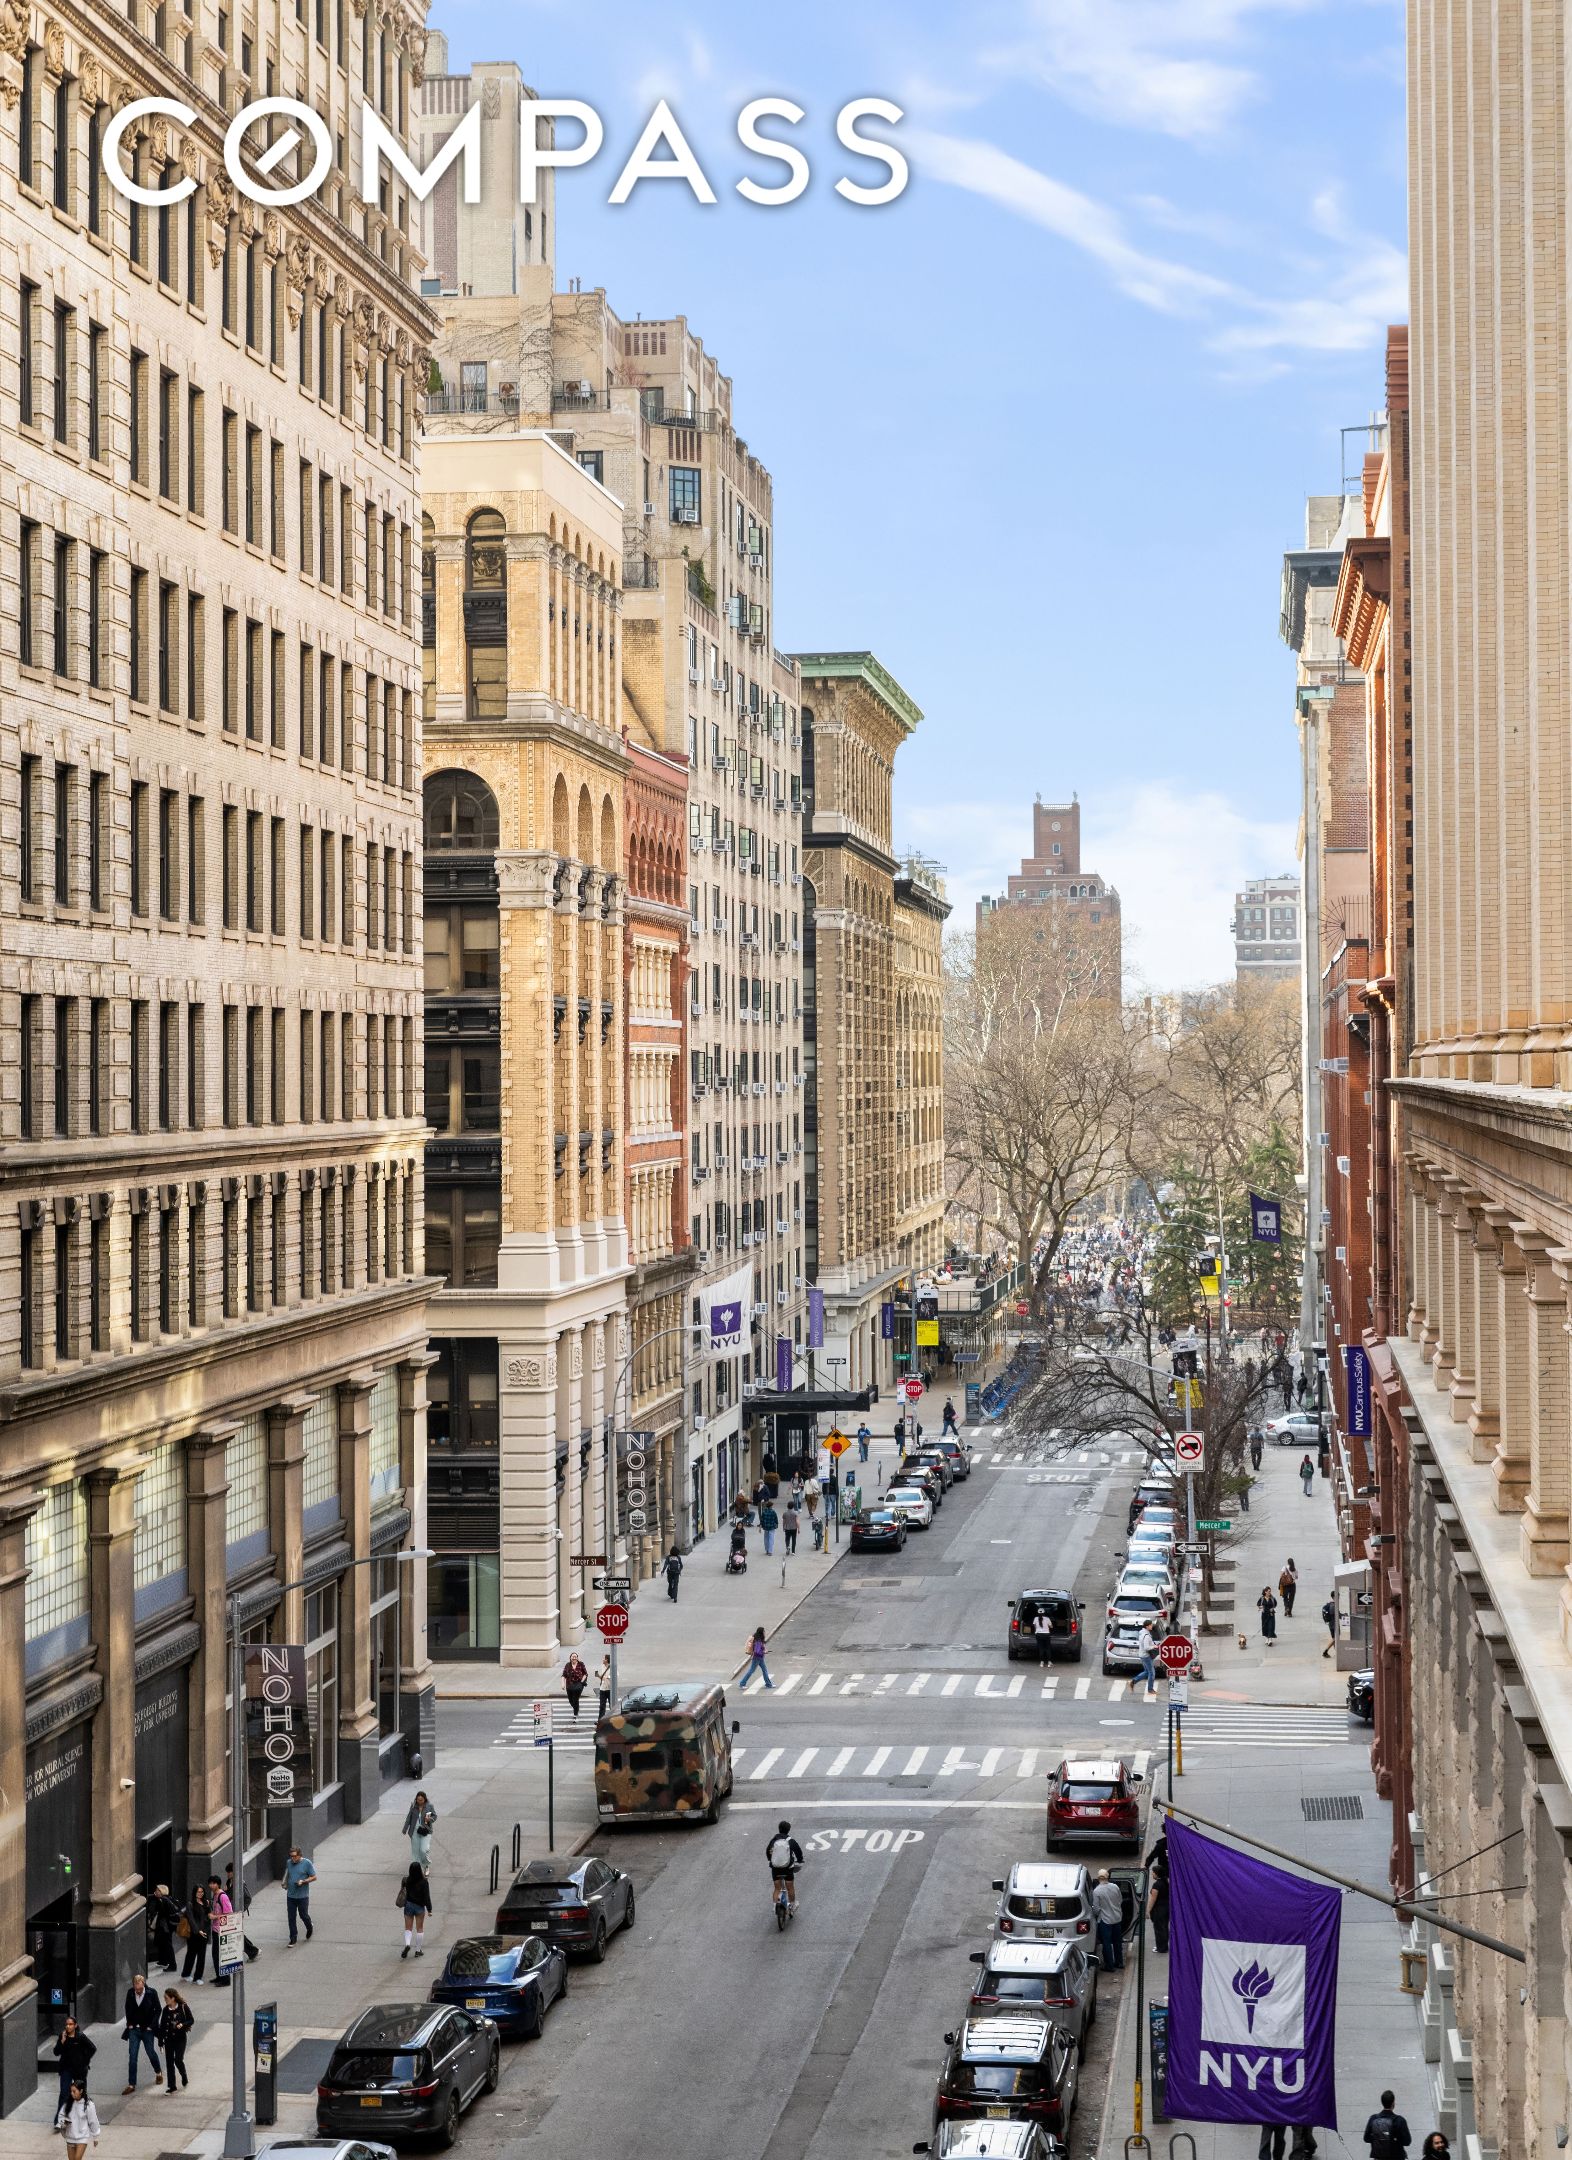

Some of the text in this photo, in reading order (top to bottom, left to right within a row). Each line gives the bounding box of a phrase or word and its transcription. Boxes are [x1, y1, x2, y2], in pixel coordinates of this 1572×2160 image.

[1258, 1228, 1277, 1236] NYU
[711, 1333, 741, 1349] NYU
[906, 1385, 921, 1393] STOP
[626, 1433, 647, 1508] NOHO
[1026, 1474, 1089, 1483] STOP
[1199, 1521, 1221, 1529] Mercer
[570, 1558, 597, 1566] Mercer St
[598, 1614, 628, 1627] STOP
[1161, 1645, 1192, 1659] STOP
[261, 1647, 295, 1763] NOHO
[33, 1780, 48, 1797] YORK
[49, 1762, 77, 1788] UNIVERSITY
[805, 1829, 925, 1853] STOP
[261, 2021, 269, 2033] P
[1199, 2050, 1306, 2094] NYU
